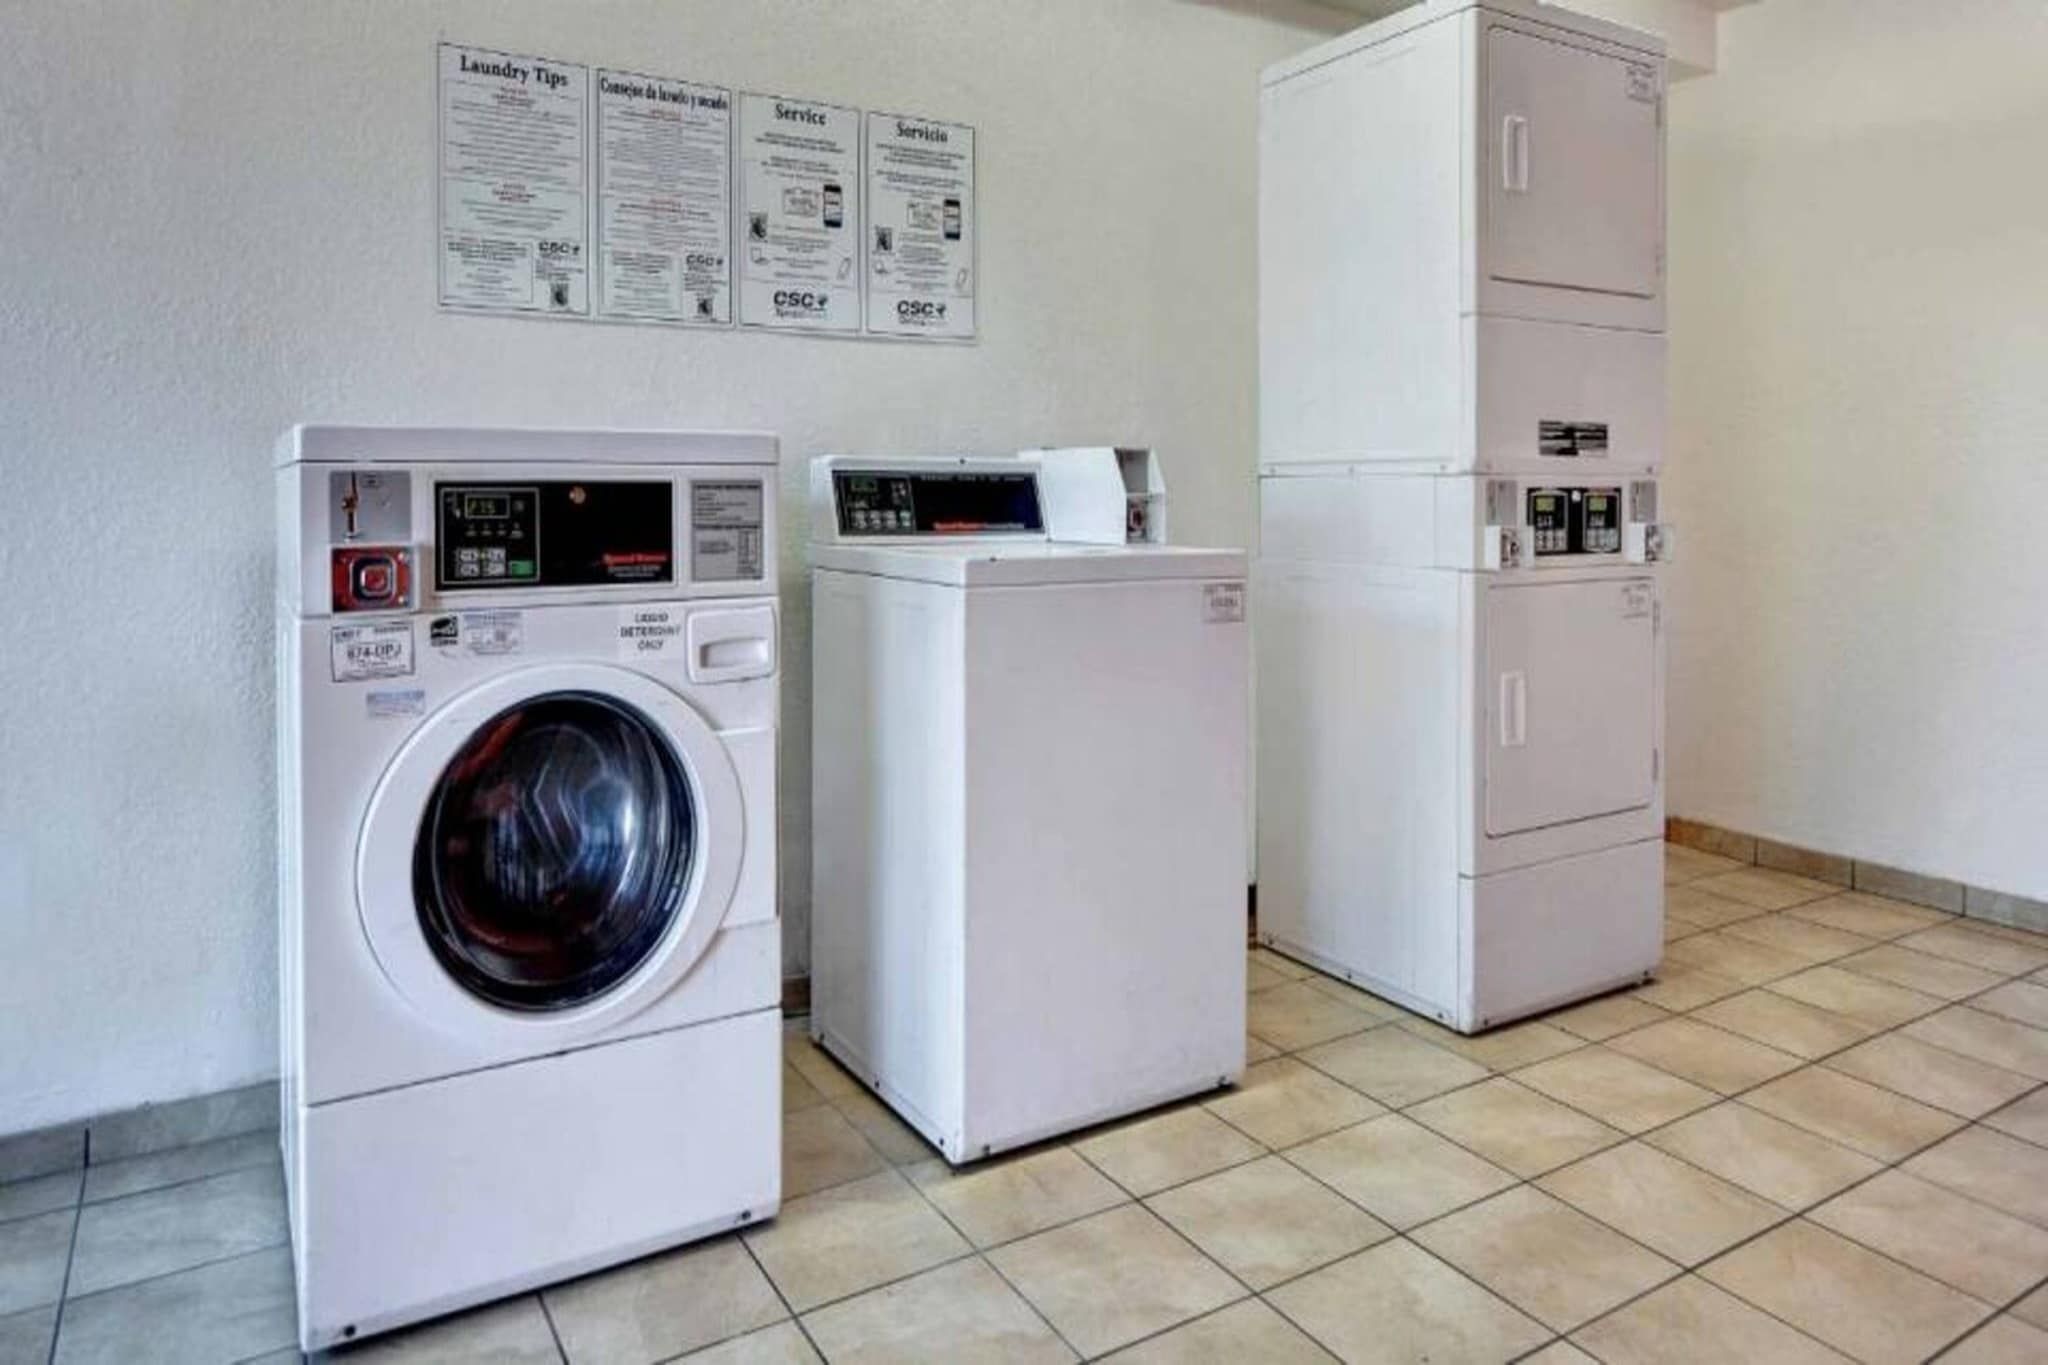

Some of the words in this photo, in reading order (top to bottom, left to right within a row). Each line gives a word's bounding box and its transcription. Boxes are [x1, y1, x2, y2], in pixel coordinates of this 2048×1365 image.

[460, 54, 529, 85] Laundry
[533, 66, 569, 89] Tips
[775, 103, 826, 126] Service
[896, 121, 948, 142] Servicio
[773, 290, 815, 309] CSC
[897, 299, 934, 315] CSC
